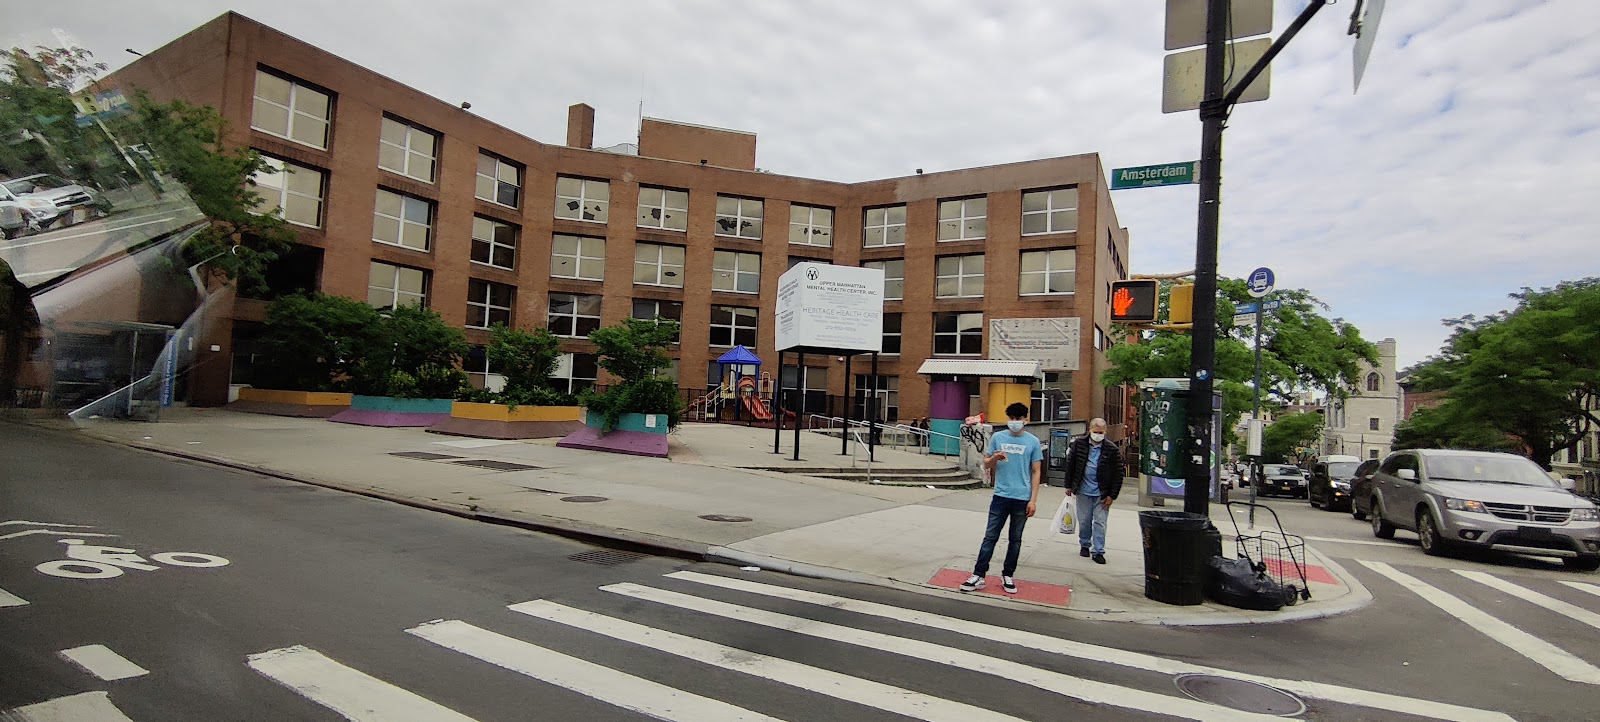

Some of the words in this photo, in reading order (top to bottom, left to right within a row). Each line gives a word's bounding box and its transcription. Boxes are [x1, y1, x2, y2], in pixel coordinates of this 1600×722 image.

[1120, 166, 1187, 181] Amsterdam
[802, 307, 835, 315] HERITAGE
[836, 308, 862, 317] HEALTH
[863, 311, 879, 319] CARE
